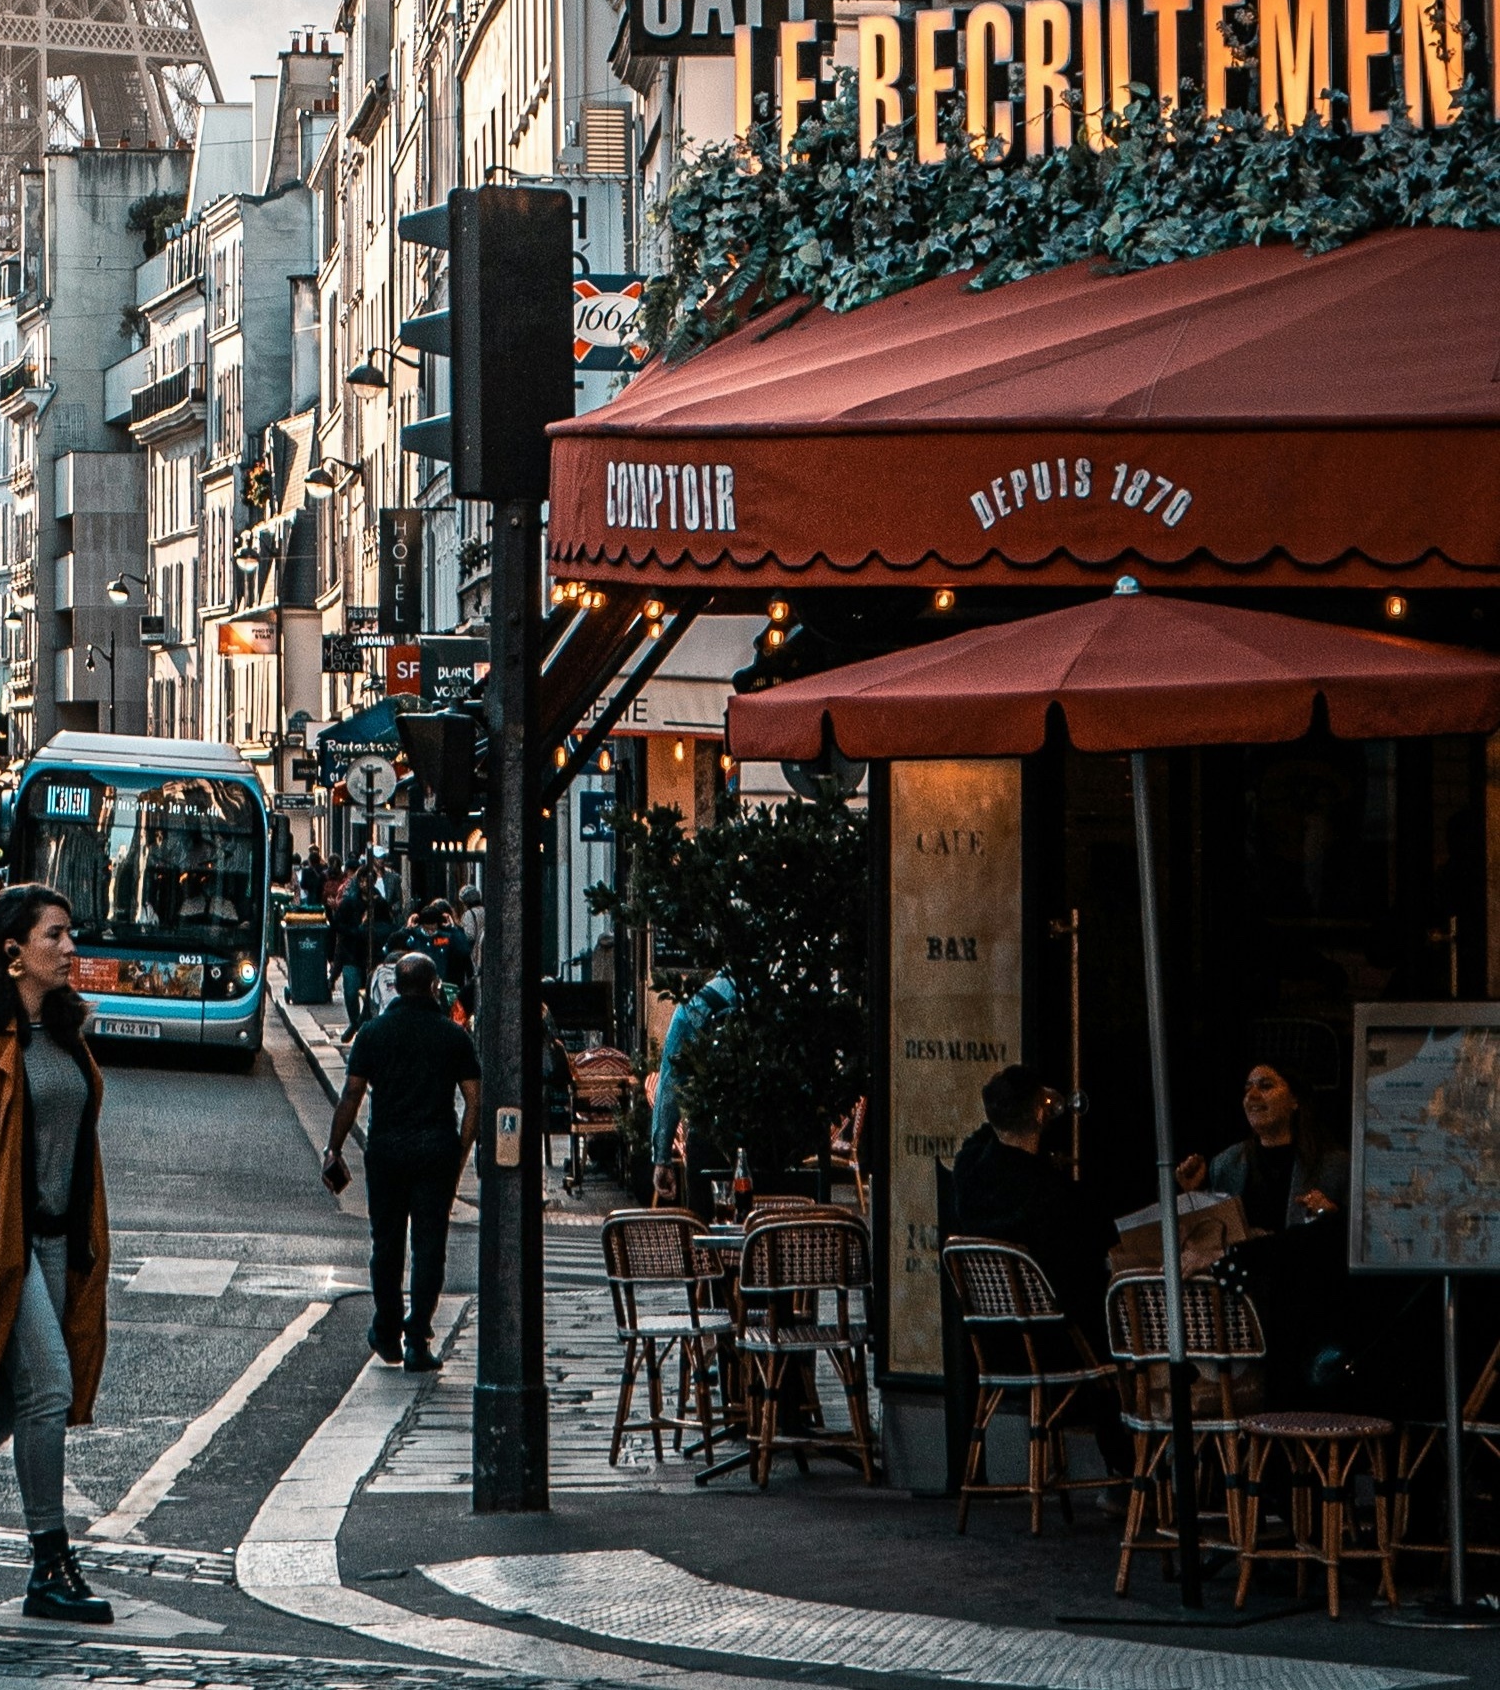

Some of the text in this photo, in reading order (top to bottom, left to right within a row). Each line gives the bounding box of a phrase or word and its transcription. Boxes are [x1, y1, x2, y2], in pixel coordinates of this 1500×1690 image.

[576, 302, 636, 333] 1664
[606, 460, 736, 531] COMPTOIR
[969, 457, 1193, 531] DEPUIS 1870
[353, 635, 395, 646] JAPONAIS
[438, 667, 472, 680] BLANC
[178, 955, 203, 965] 0623
[926, 935, 978, 962] BAR
[905, 1039, 1008, 1062] RESTAURANT
